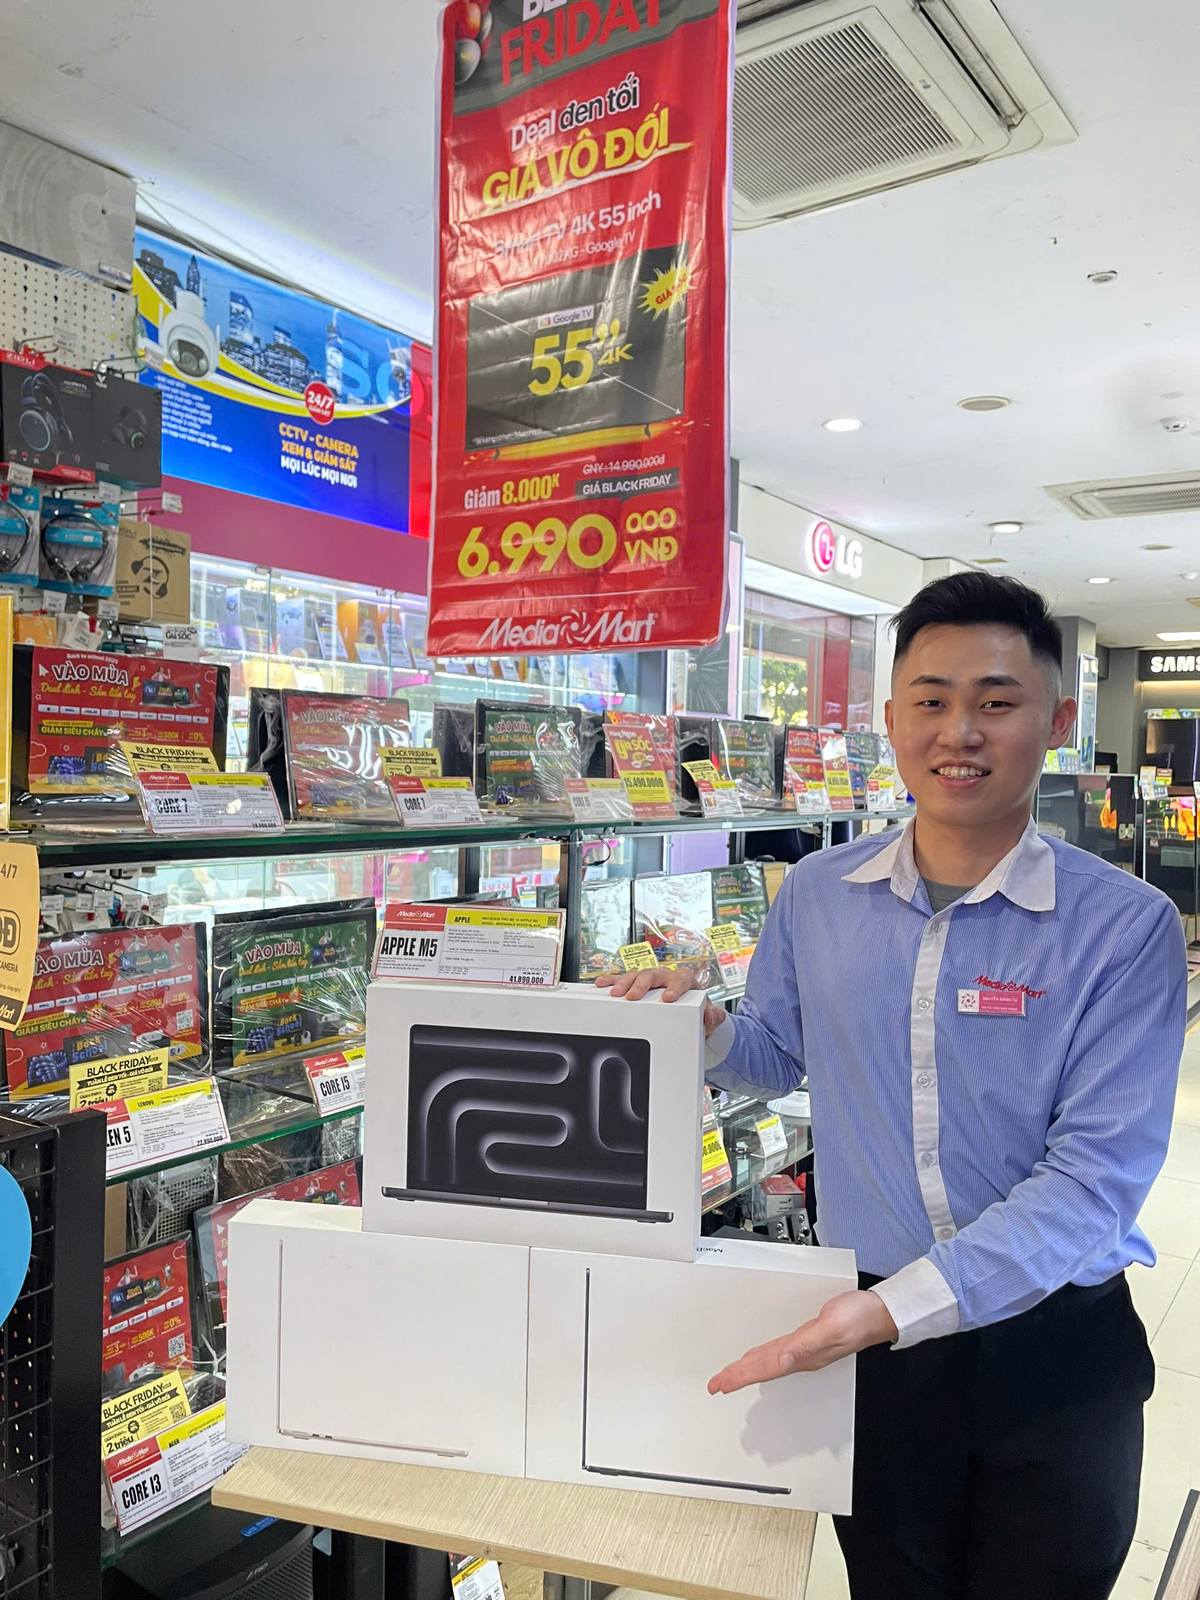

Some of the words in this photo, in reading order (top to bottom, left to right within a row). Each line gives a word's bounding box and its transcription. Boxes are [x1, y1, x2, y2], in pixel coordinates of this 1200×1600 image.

[511, 109, 556, 152] Deal
[559, 94, 604, 132] đen
[606, 72, 640, 113] tối
[547, 128, 598, 187] VÔ
[604, 103, 669, 169] ĐỐI
[569, 211, 595, 235] 4K
[598, 205, 625, 229] 55
[627, 190, 661, 222] inch
[586, 237, 621, 255] Google
[622, 230, 636, 246] TV
[655, 289, 672, 305] GIÁ
[553, 310, 579, 325] Google
[580, 308, 592, 320] TV
[598, 342, 634, 367] 4K
[307, 391, 333, 409] 24/7
[279, 422, 308, 442] CCTV
[315, 434, 359, 458] CAMERA
[282, 440, 304, 457] XEM
[305, 447, 312, 459] &
[313, 450, 338, 467] GIÁM
[339, 457, 357, 472] SÁT
[609, 454, 665, 472] 14.990.000đ
[281, 455, 301, 474] MỌI
[301, 461, 321, 478] LÚC
[321, 467, 339, 485] MỌI
[464, 486, 500, 510] Giảm
[502, 473, 560, 505] 8.000K
[582, 483, 601, 495] GIÁ
[602, 479, 638, 494] BLACK
[639, 473, 672, 489] FRIDAY
[457, 513, 617, 579] 6.990
[626, 507, 677, 534] 000
[624, 535, 679, 565] VNĐ
[837, 534, 863, 579] LG
[476, 616, 560, 647] Media
[582, 610, 656, 644] Mart
[51, 660, 90, 681] VÀO
[92, 664, 129, 686] MÙA
[40, 682, 62, 692] Deal
[89, 685, 107, 696] Sắm
[124, 689, 136, 702] tay
[301, 707, 325, 724] VÀO
[494, 719, 512, 733] VÀO
[64, 726, 83, 735] SIÊU
[83, 728, 103, 737] CHÁY
[621, 731, 636, 739] Ngon
[135, 746, 165, 756] BLACK
[165, 747, 195, 757] FRIDAY
[631, 735, 653, 752] sốc
[183, 798, 188, 813] 7
[404, 798, 421, 811] CORE
[422, 797, 426, 810] 7
[245, 945, 273, 963] VÀO
[274, 939, 302, 957] MÙA
[381, 936, 416, 956] APPLE
[418, 938, 438, 957] M5
[33, 956, 61, 977] ÀO
[64, 949, 104, 969] MÙA
[100, 968, 114, 980] tay
[972, 975, 1006, 991] Media
[1015, 984, 1044, 999] Mart
[40, 1021, 61, 1032] SIÊU
[61, 1016, 81, 1028] CHÁY
[277, 1019, 302, 1037] School
[280, 1013, 297, 1026] Back
[87, 1063, 118, 1077] BLACK
[119, 1055, 151, 1071] FRIDAY
[320, 1079, 341, 1097] CORE
[137, 1100, 154, 1108] LENOVO
[106, 1128, 122, 1148] EN
[123, 1126, 131, 1143] 5
[169, 1316, 181, 1327] 0%
[102, 1398, 132, 1419] BLACK
[132, 1383, 164, 1404] FRIDAY
[106, 1442, 113, 1453] 2
[114, 1436, 134, 1450] triệu
[168, 1439, 180, 1448] ACER
[117, 1454, 133, 1467] Media
[136, 1446, 149, 1458] Mart
[122, 1480, 148, 1509] CORE
[150, 1474, 162, 1495] I3
